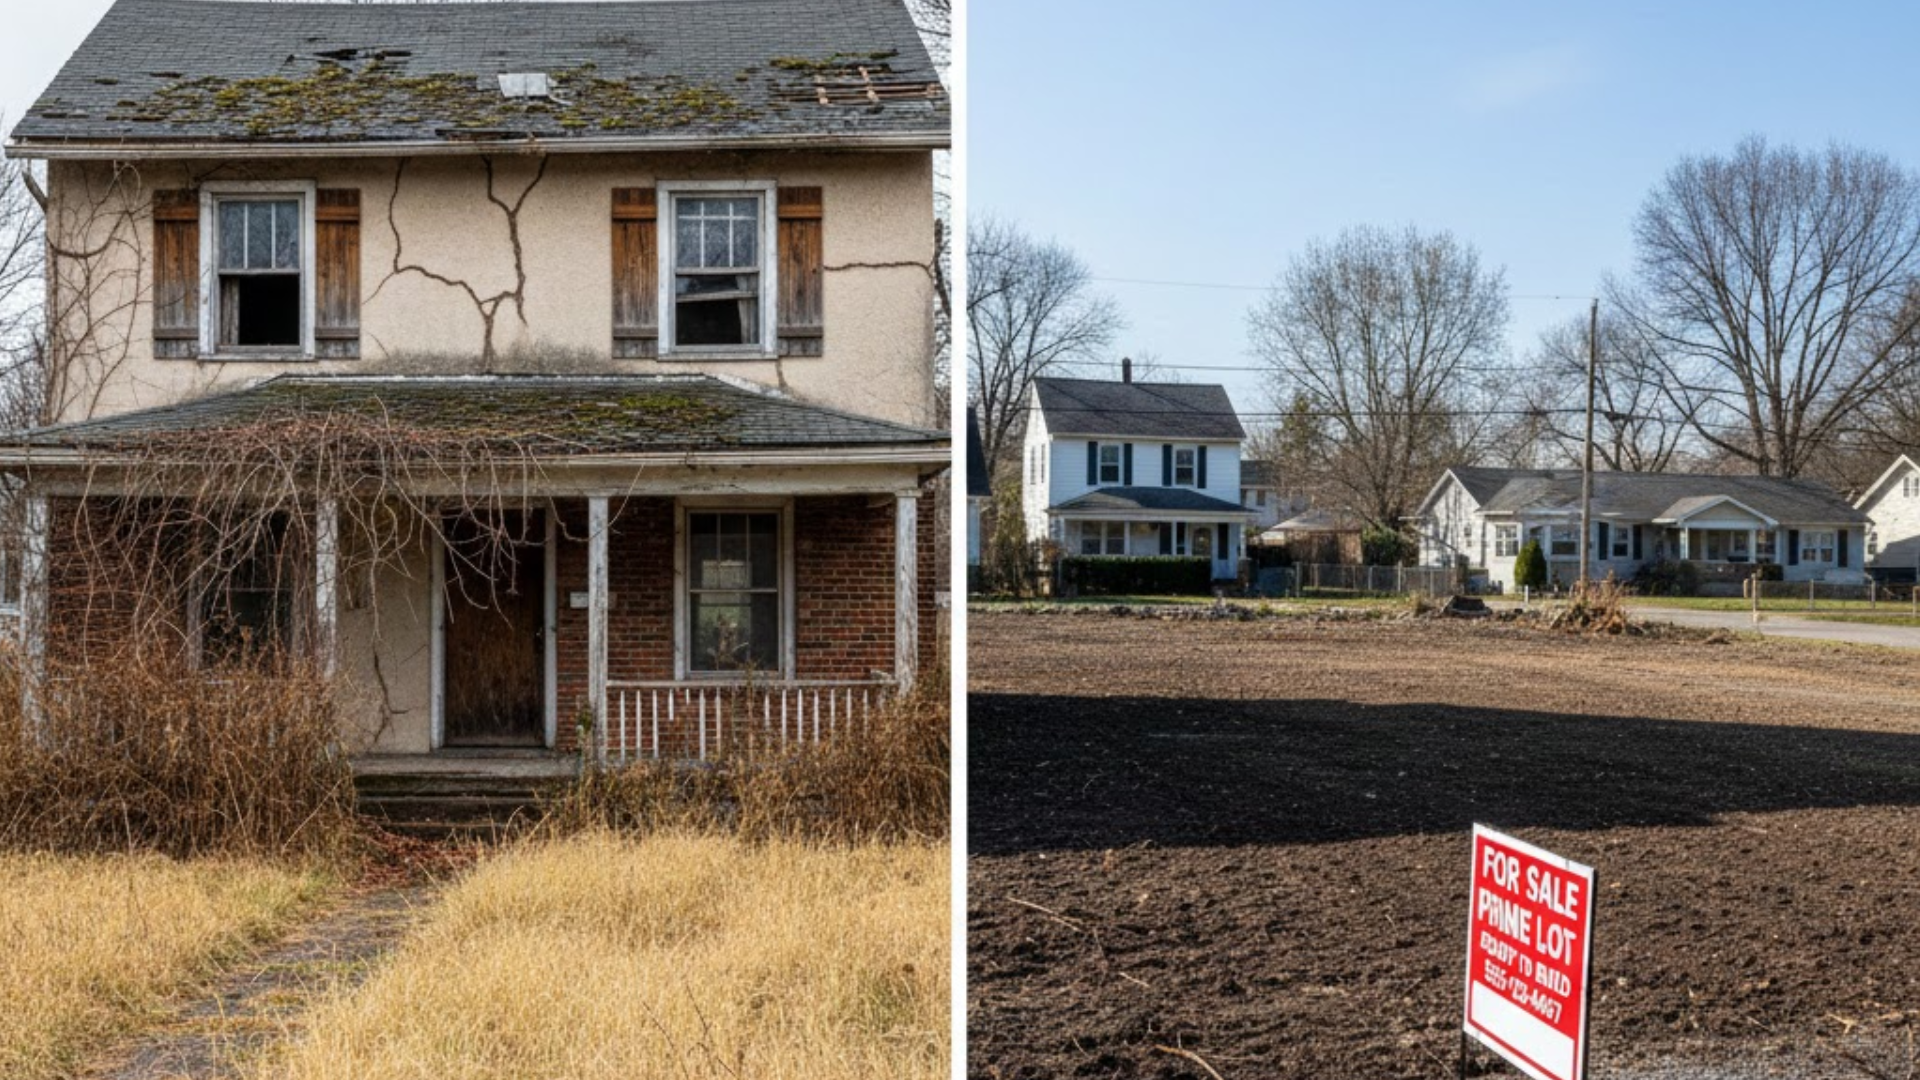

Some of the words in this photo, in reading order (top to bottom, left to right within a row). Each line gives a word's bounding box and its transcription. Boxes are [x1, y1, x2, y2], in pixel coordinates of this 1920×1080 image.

[1482, 845, 1520, 895] FOR
[1526, 865, 1579, 921] SALE
[1537, 915, 1577, 966] LOT
